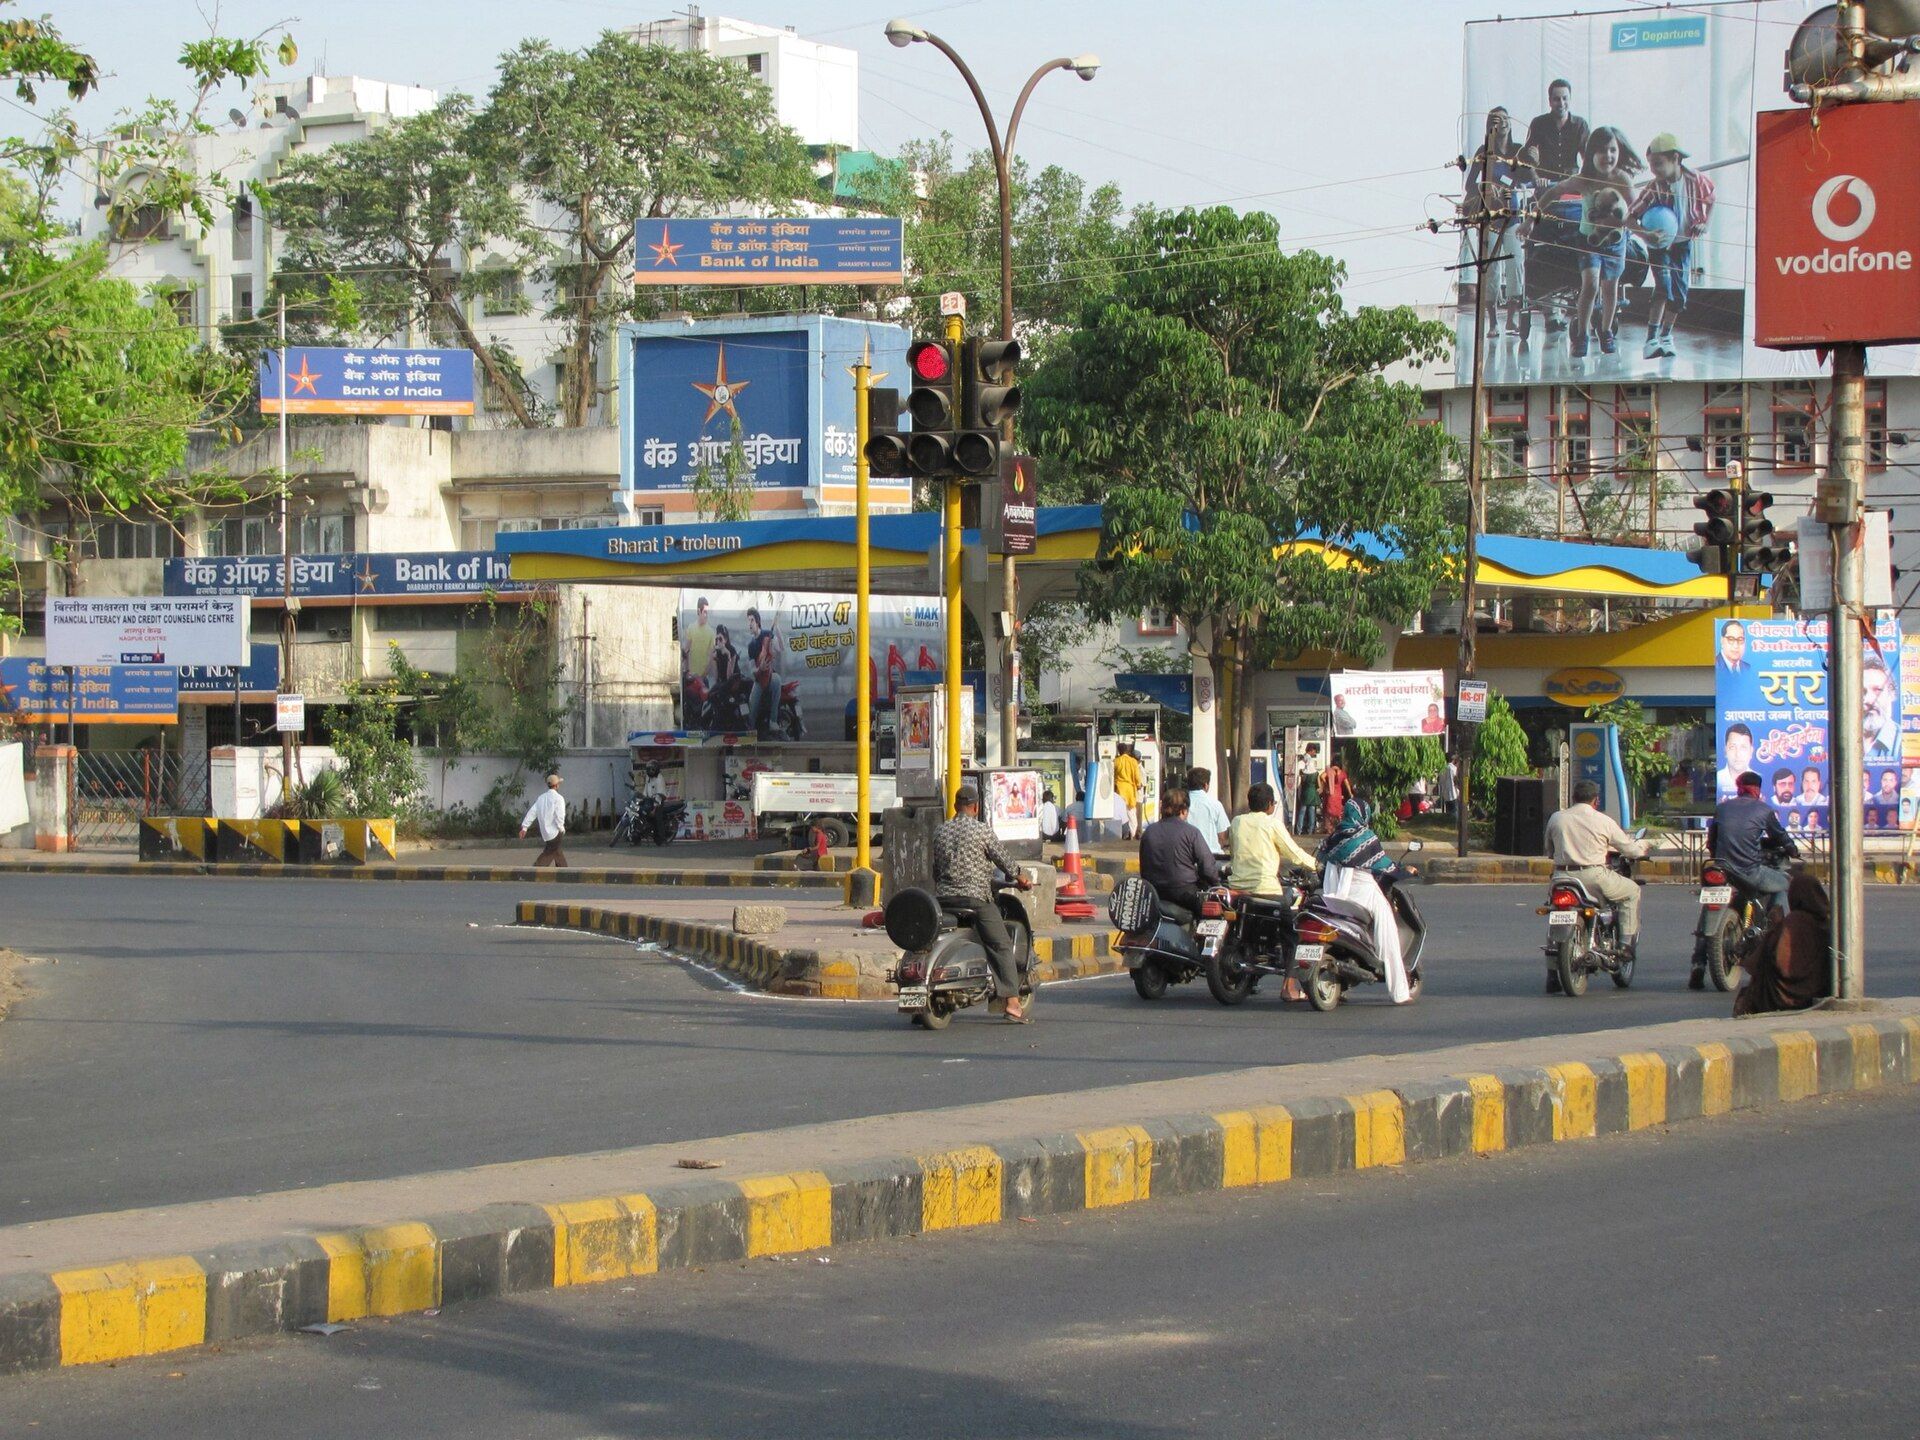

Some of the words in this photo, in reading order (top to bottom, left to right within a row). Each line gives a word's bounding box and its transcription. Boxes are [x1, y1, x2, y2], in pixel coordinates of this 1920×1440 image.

[1642, 28, 1700, 43] Departures
[771, 222, 810, 237] इंडिया
[700, 255, 746, 268] Bank
[751, 255, 769, 268] of
[775, 255, 819, 268] India
[1775, 246, 1912, 275] vodafone
[405, 354, 441, 368] इंडिया
[405, 370, 441, 383] इंडिया
[343, 385, 380, 396] Bank
[384, 385, 400, 396] of
[404, 386, 442, 396] India
[824, 425, 847, 457] बैंक
[643, 438, 677, 468] बैंक
[743, 433, 802, 469] इंडिया
[1003, 502, 1034, 520] Anandam
[608, 536, 659, 554] Bharat
[664, 534, 741, 552] Ptroleum
[184, 557, 218, 585] बैंक
[223, 557, 270, 583] ऑफ
[396, 557, 452, 580] Bank
[457, 557, 480, 580] of
[444, 582, 466, 591] BRANCH
[53, 614, 88, 625] FINANCIAL
[89, 614, 121, 625] LITERACY
[122, 614, 137, 624] AND
[138, 614, 162, 624] CREDIT
[163, 613, 206, 624] COUNSELING
[208, 613, 235, 623] CENTRE
[791, 602, 830, 629] MAK
[833, 601, 852, 625] 4T
[914, 606, 939, 621] MAK
[1179, 680, 1187, 693] 3
[1758, 670, 1826, 706] सर
[20, 696, 58, 709] Bank
[62, 696, 77, 709] of
[82, 697, 119, 709] India
[1460, 691, 1485, 702] MS-CIT
[1121, 877, 1138, 930] NANGIA
